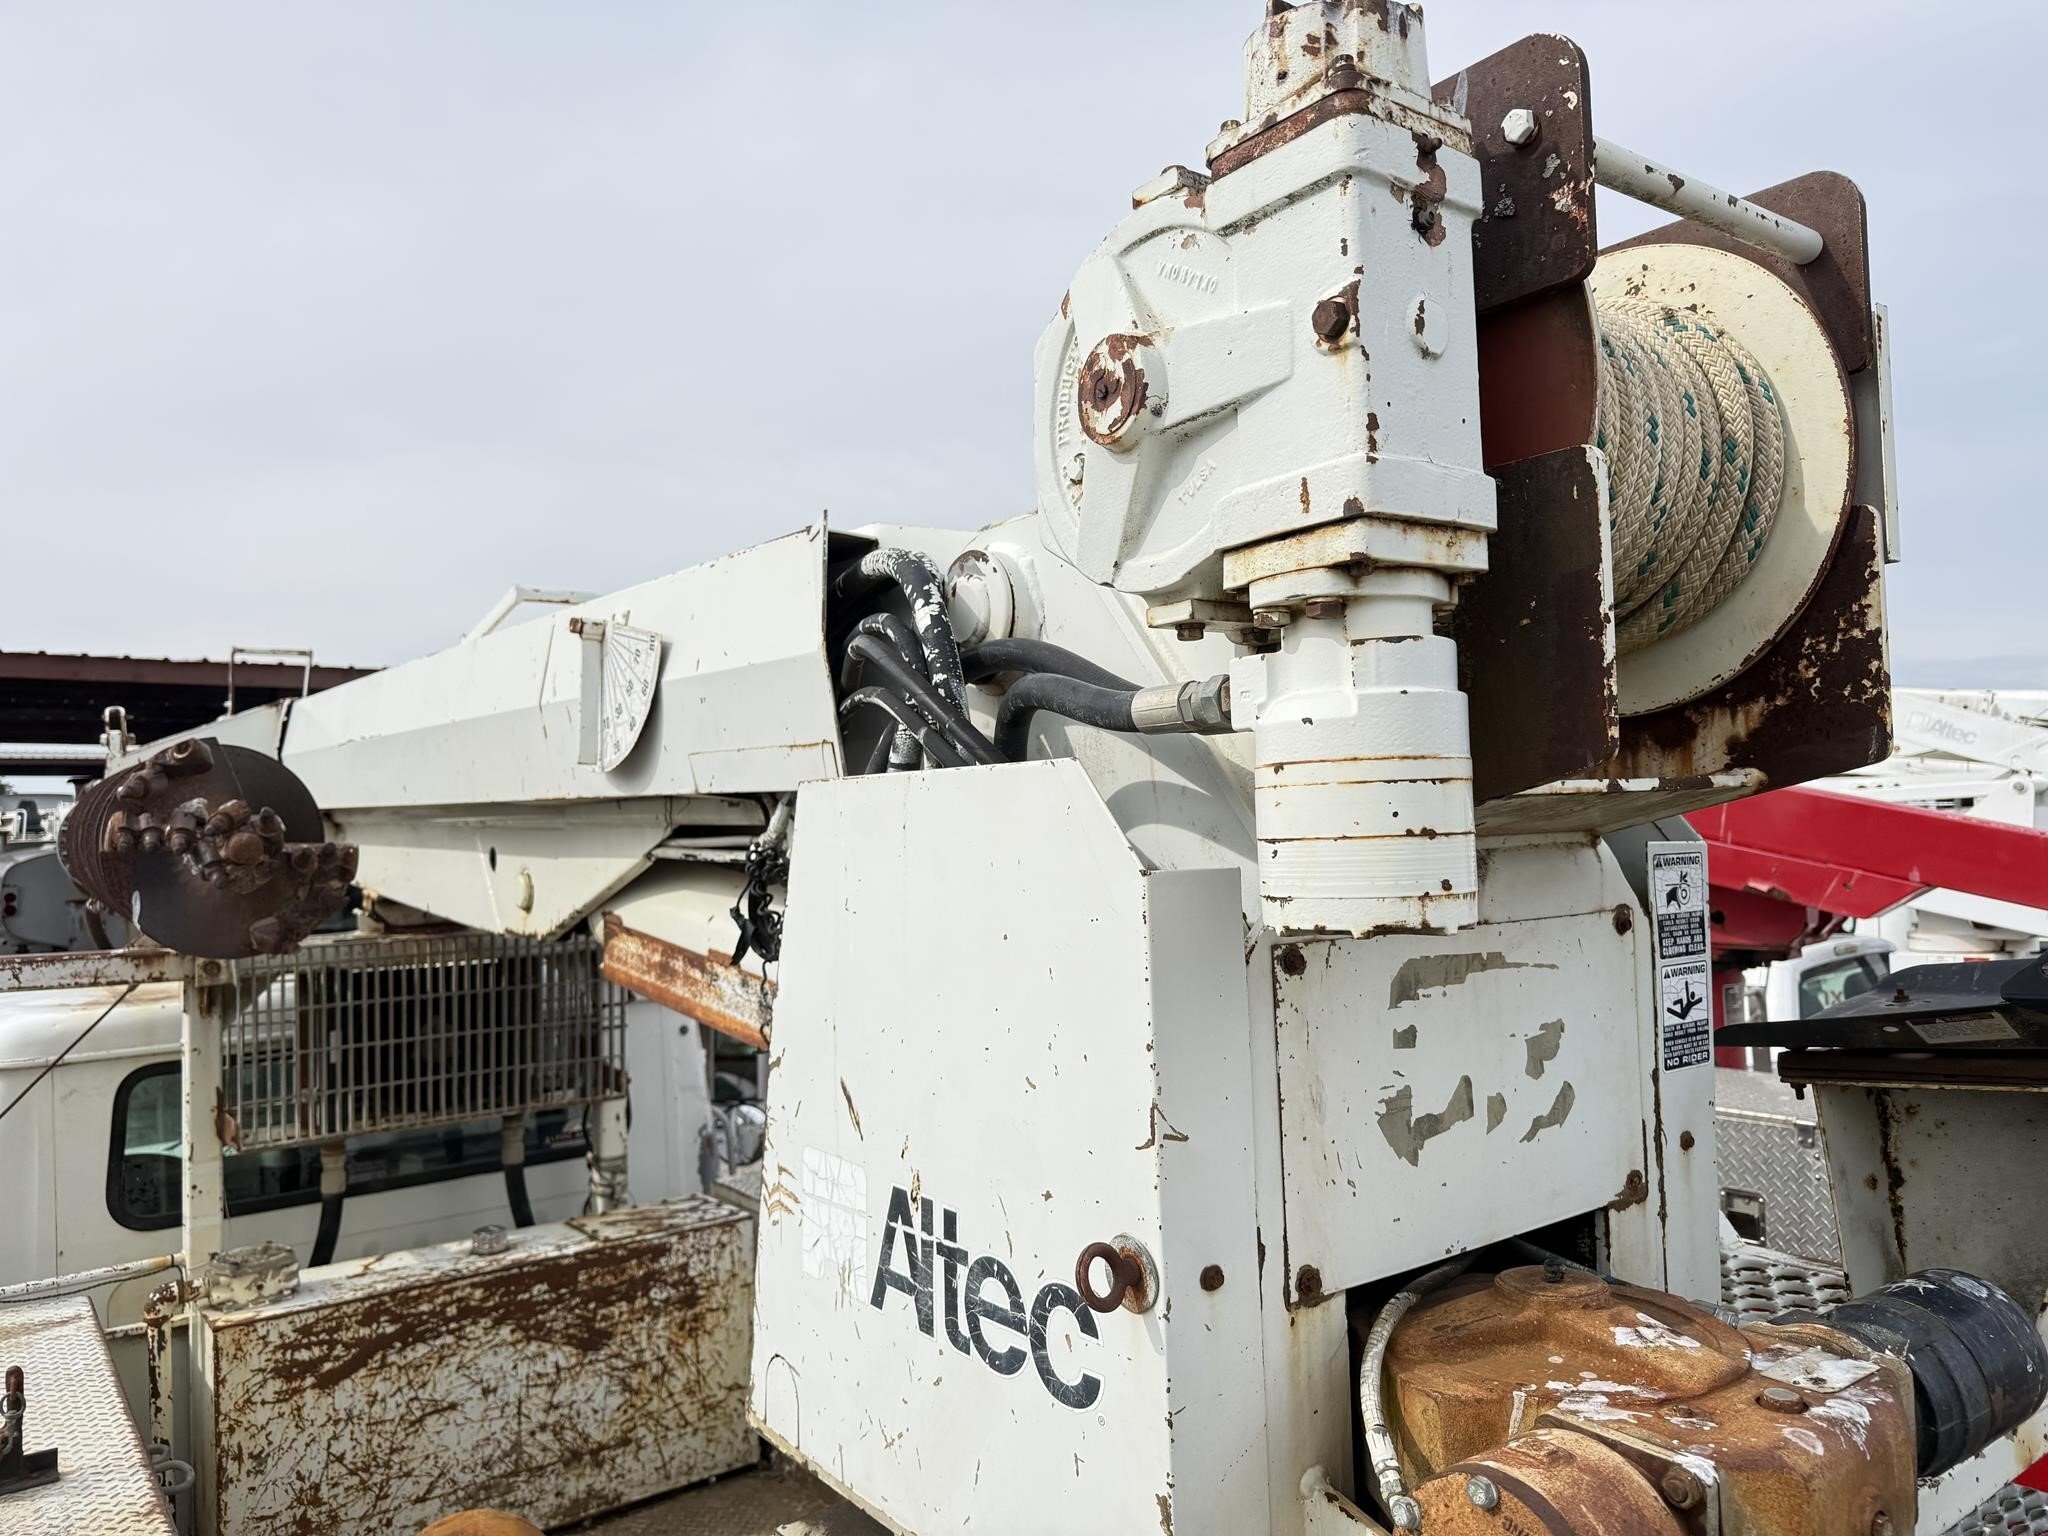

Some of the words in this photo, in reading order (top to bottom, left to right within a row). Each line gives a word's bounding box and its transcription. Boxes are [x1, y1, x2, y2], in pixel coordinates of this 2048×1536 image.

[1178, 460, 1217, 506] TULSA
[633, 649, 641, 665] 70
[641, 679, 649, 696] 60
[1928, 719, 1977, 744] Altec
[1663, 856, 1700, 867] WARNING
[1677, 936, 1692, 944] HANDS
[1663, 946, 1686, 955] CLOTHING
[1671, 964, 1706, 978] WARNING
[1667, 1058, 1680, 1067] NO
[1683, 1052, 1708, 1064] RIDER
[871, 1185, 1103, 1412] Altec
